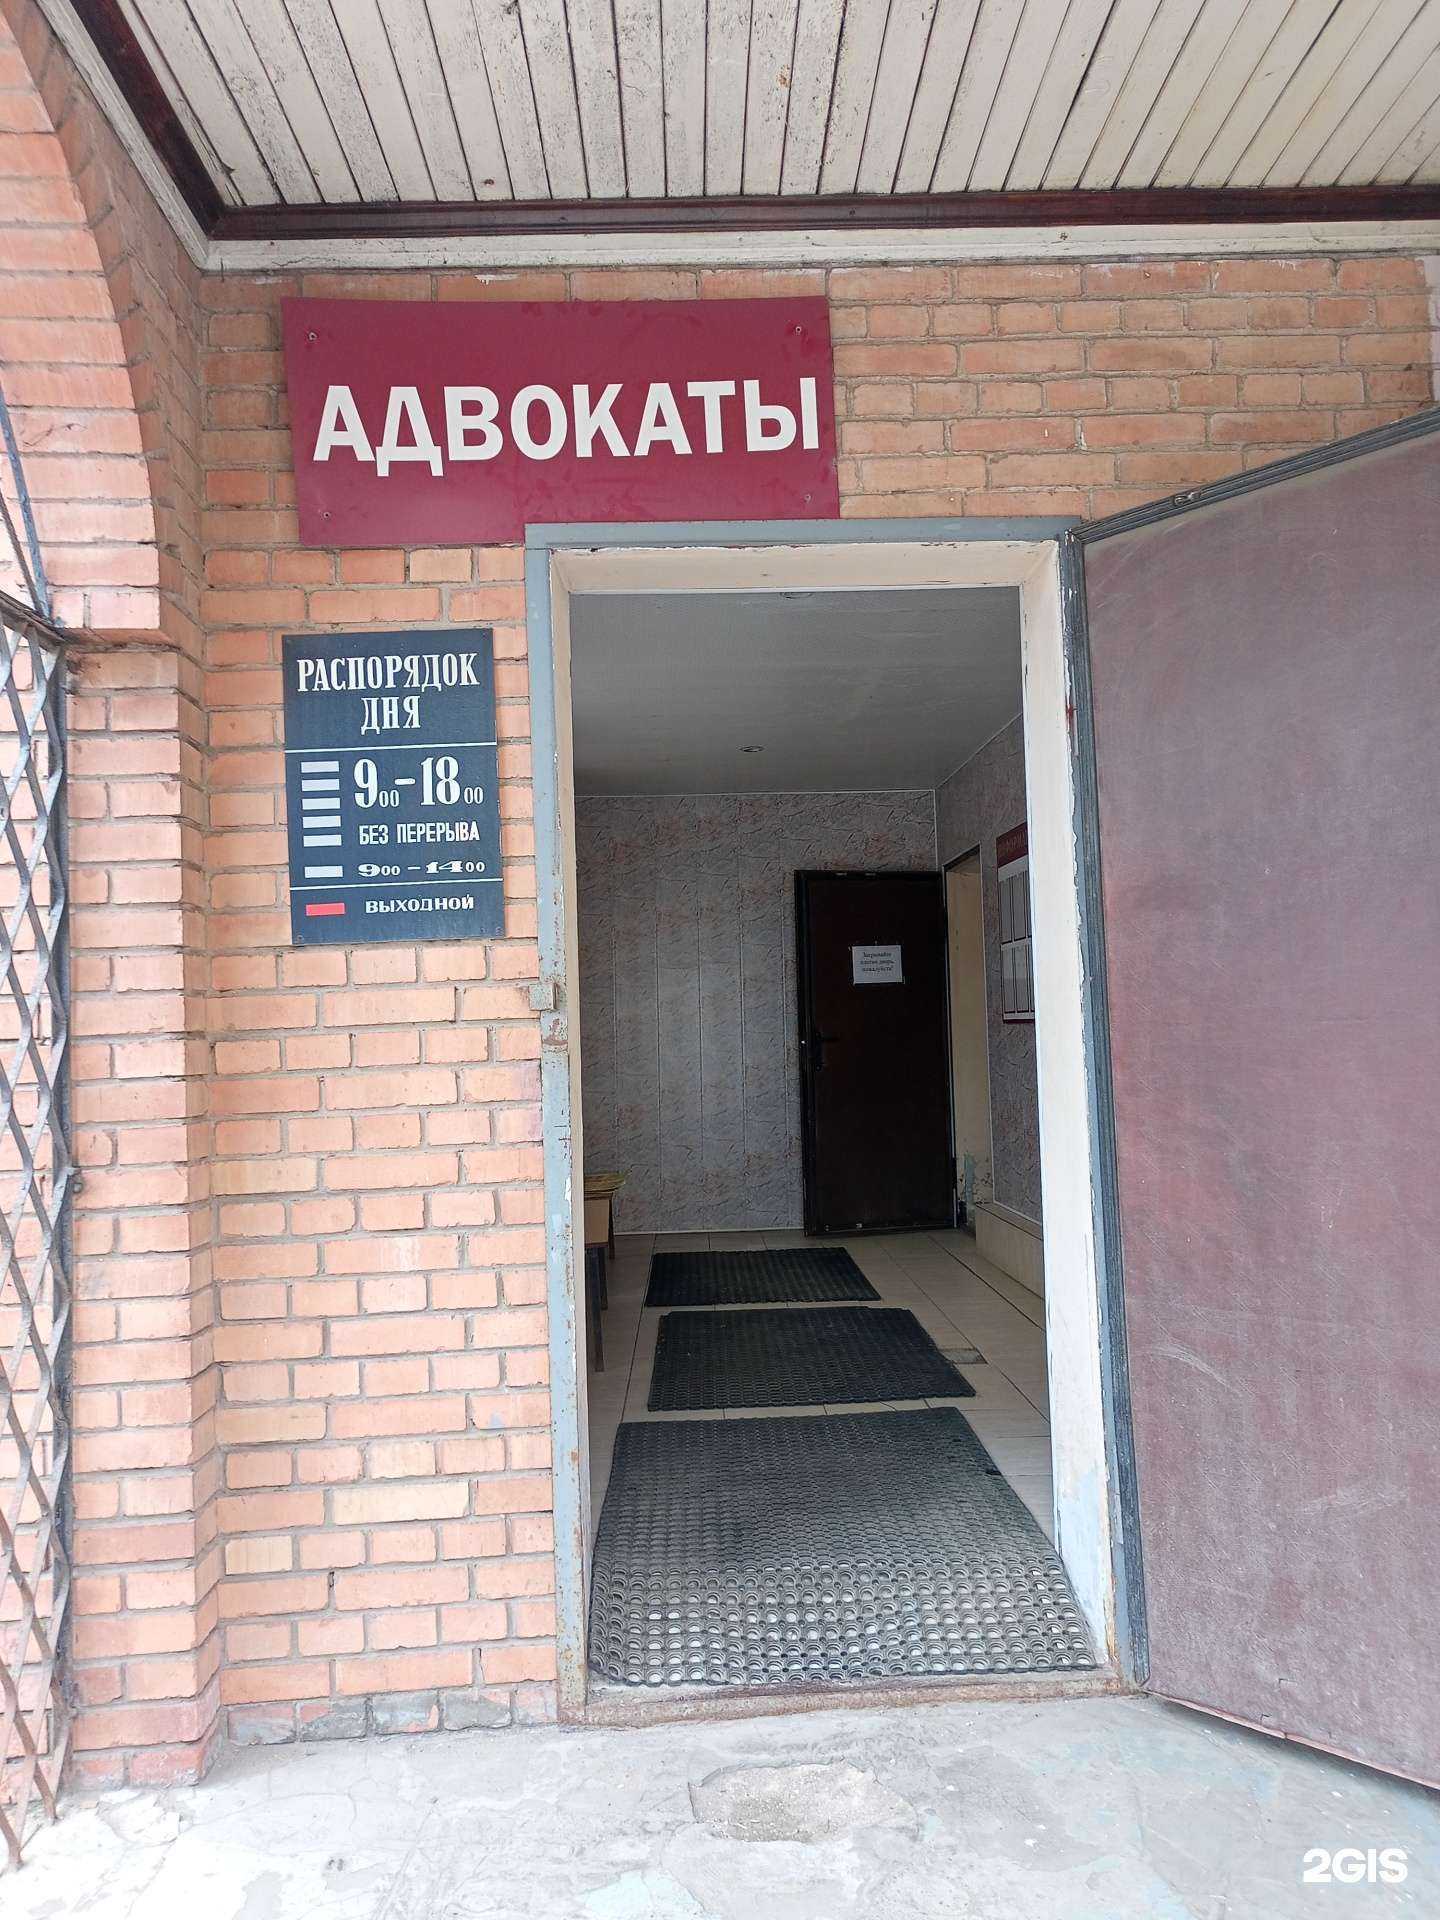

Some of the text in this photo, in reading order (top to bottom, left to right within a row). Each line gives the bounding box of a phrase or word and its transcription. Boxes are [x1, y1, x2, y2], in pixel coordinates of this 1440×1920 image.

[313, 376, 820, 477] АДВОКАТЫ
[297, 652, 481, 693] РАСПОРЯДОК
[360, 695, 422, 735] ДНЯ
[358, 820, 480, 846] БЕЗ ПЕРЕРЫВА
[365, 893, 475, 914] ВЫХОДНОЙ
